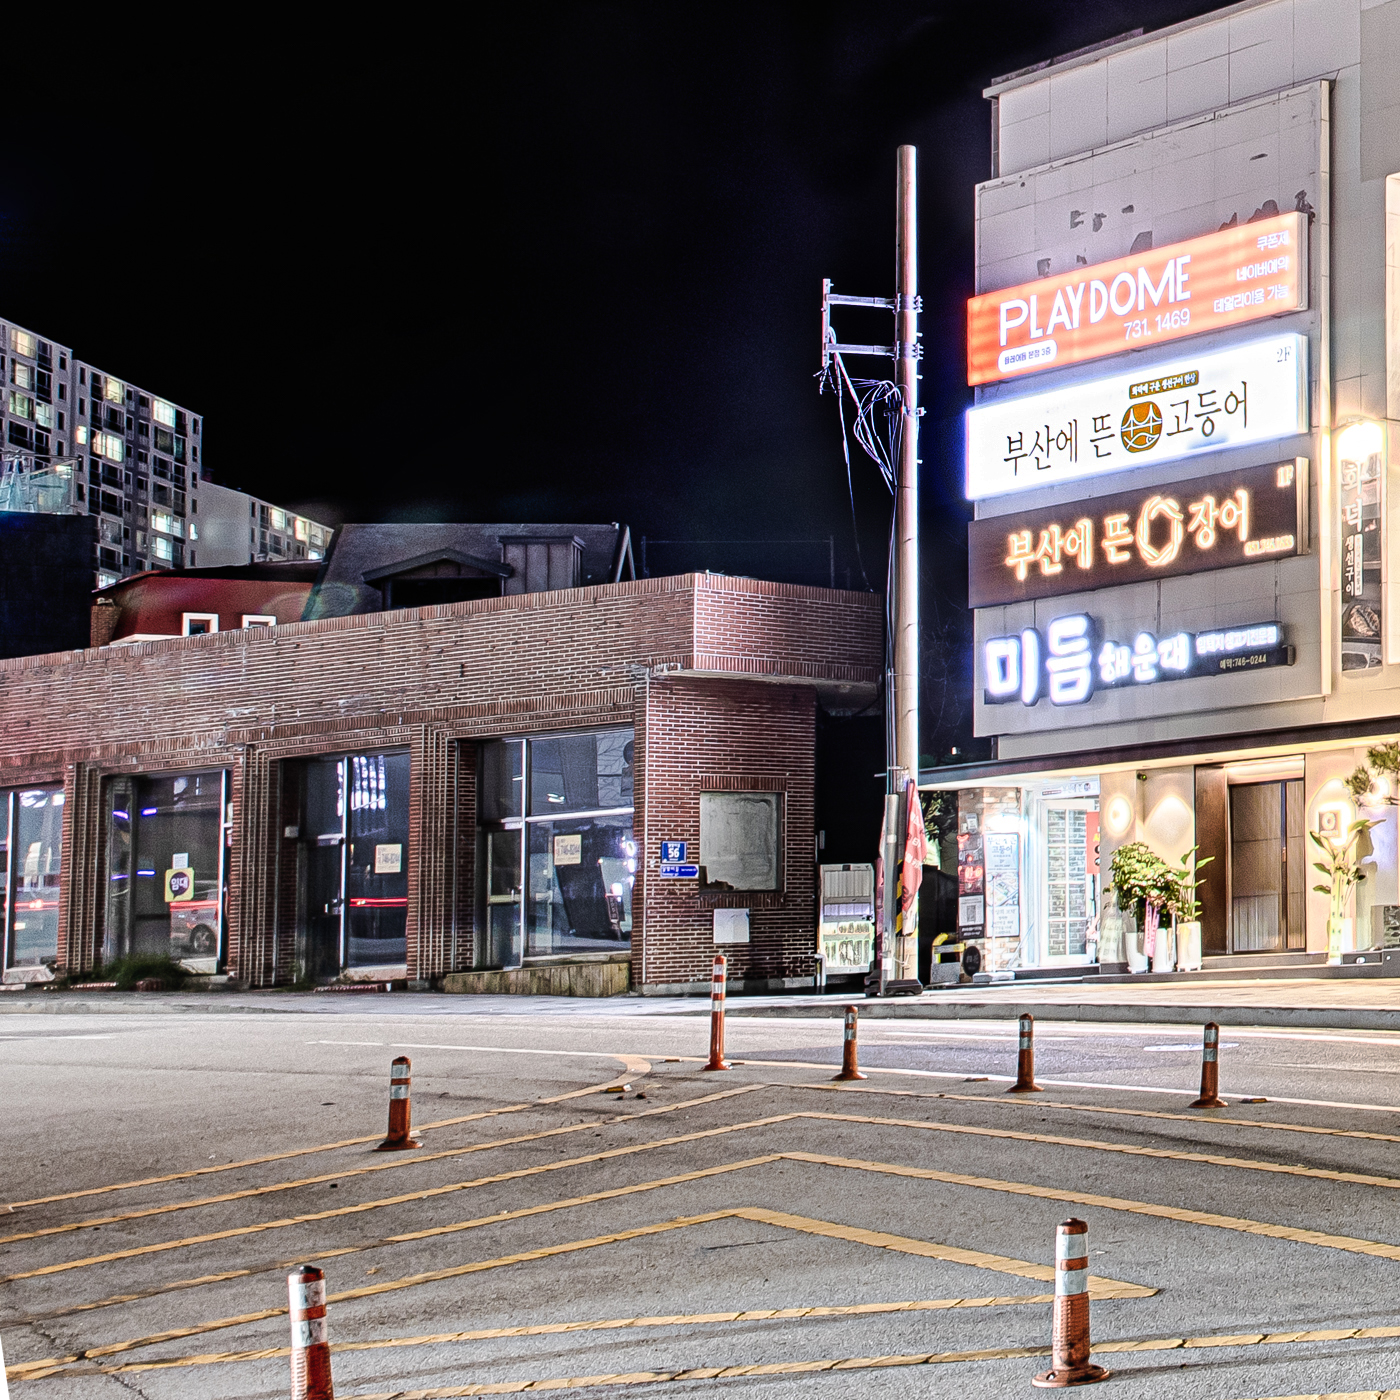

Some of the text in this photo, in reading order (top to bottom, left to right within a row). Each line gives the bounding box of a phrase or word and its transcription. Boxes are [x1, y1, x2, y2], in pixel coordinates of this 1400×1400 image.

[1256, 229, 1289, 251] 쿠폰제
[1236, 256, 1289, 281] 네이버예약
[1213, 284, 1289, 314] 데일리이용 가능
[1276, 346, 1292, 364] 2F
[1004, 381, 1247, 476] 부산에 뜬 고등어
[1277, 465, 1294, 488] 1F
[1005, 490, 1248, 581] 부산에 뜬 장어
[1345, 534, 1354, 597] 생선구이
[1098, 631, 1191, 683] 해운대
[668, 848, 680, 858] 56
[171, 876, 188, 891] 임대
